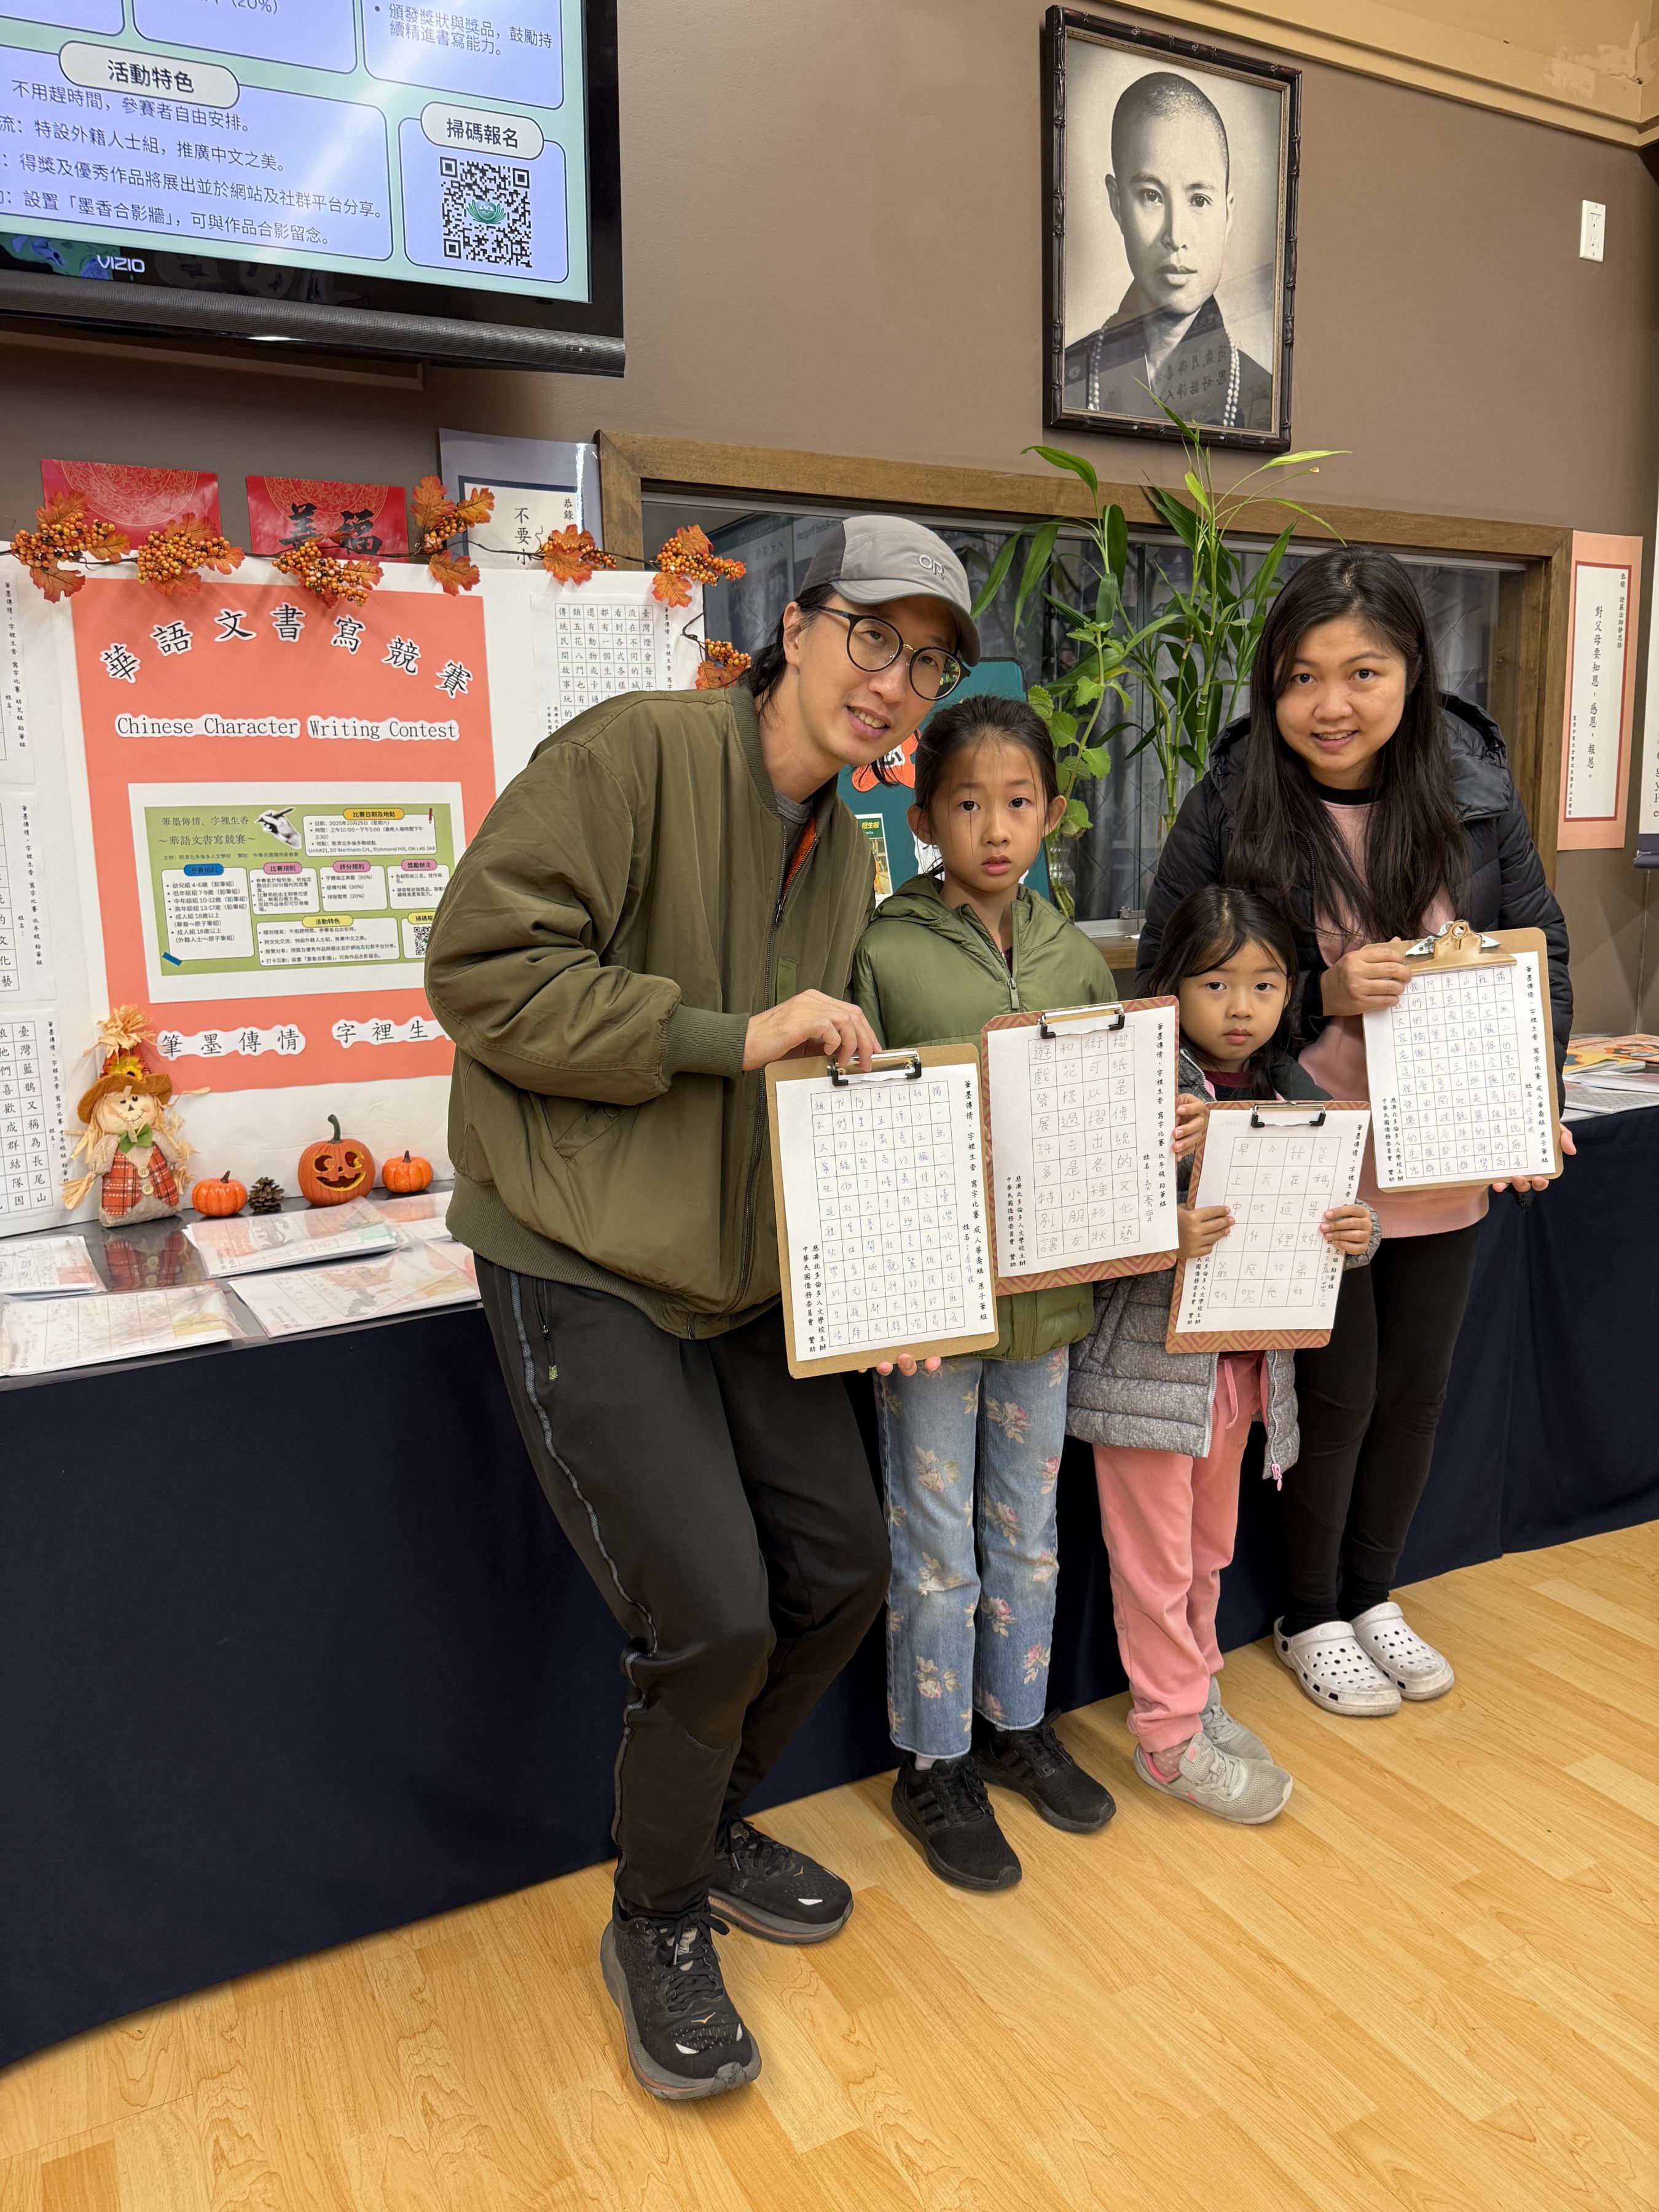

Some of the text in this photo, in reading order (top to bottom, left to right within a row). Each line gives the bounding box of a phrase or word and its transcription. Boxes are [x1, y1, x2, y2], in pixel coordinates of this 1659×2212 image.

[108, 60, 194, 94] 活動特色
[447, 118, 519, 149] 掃碼報名
[0, 153, 381, 219] ：得獎及優秀作品將展出並於網站及社群平台分享。
[96, 254, 145, 273] VIZIO
[563, 499, 574, 520] 恭錄
[514, 508, 532, 566] 不要小
[918, 554, 945, 581] OR
[103, 605, 468, 694] 華語文書寫競賽
[117, 717, 455, 739] Chinese Character Writing Contest
[161, 1019, 429, 1057] 筆墨傳情 字裡生
[19, 1026, 47, 1203] 臺灣藍鵲又稱為長尾山
